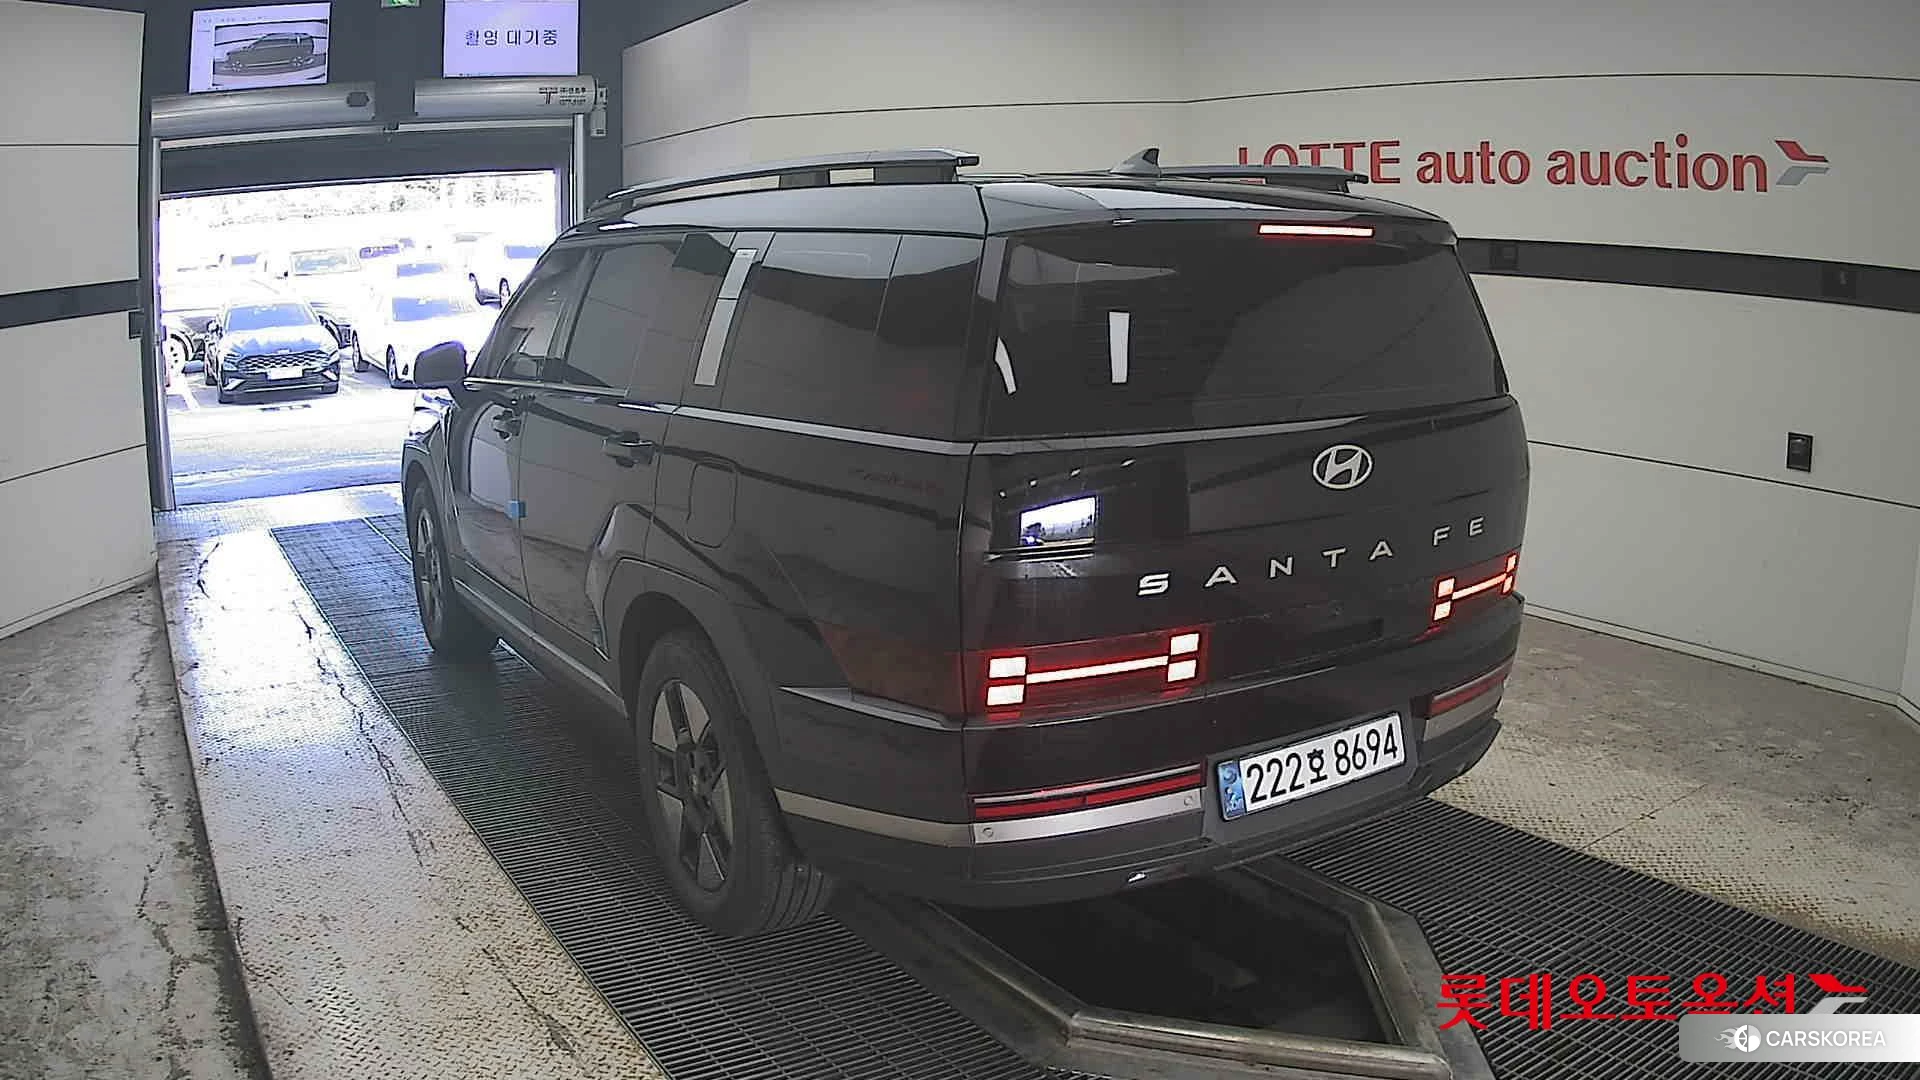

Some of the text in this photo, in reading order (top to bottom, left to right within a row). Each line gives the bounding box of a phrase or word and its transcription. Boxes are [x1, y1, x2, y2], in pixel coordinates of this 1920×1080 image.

[507, 29, 559, 46] 대기중
[1416, 141, 1531, 185] auto
[1546, 133, 1768, 192] auction
[1137, 516, 1485, 597] SANTA FE
[1246, 723, 1398, 804] 222호 8694
